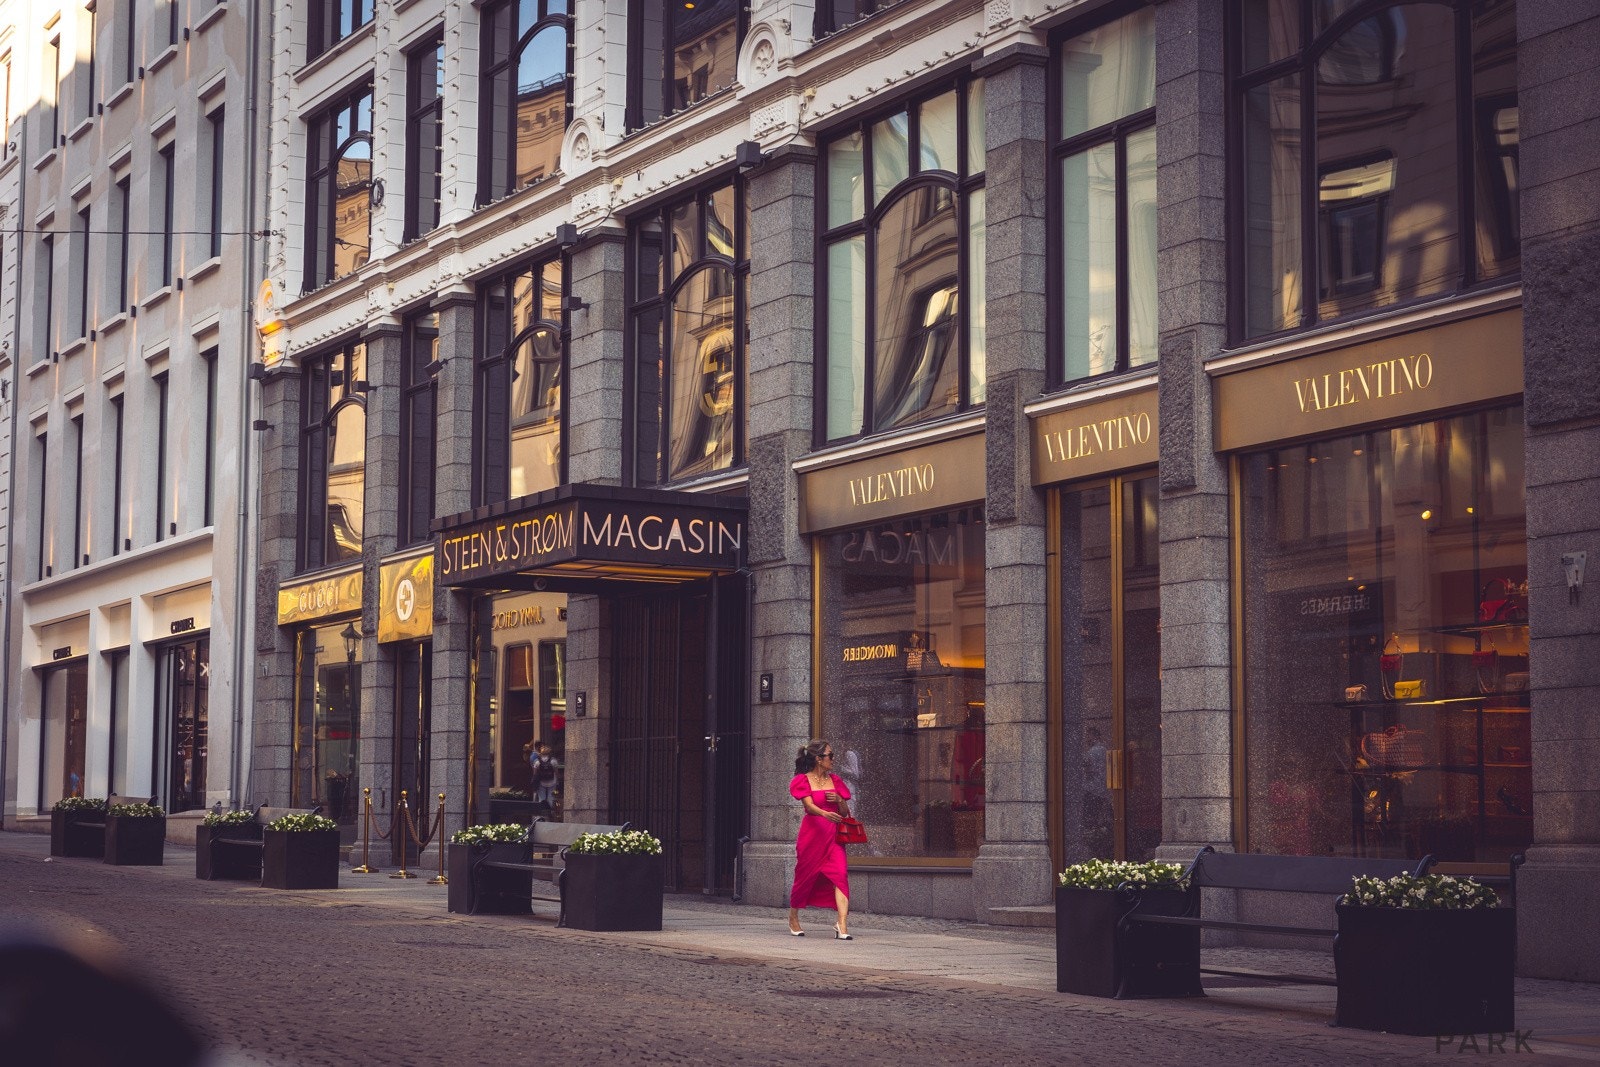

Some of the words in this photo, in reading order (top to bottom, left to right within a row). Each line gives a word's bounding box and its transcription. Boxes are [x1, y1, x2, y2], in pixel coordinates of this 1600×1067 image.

[1294, 353, 1433, 413] VALENTINO
[1044, 412, 1151, 463] VALENTINO
[849, 463, 935, 506] VALENTINO
[443, 530, 491, 574] STEEN
[495, 525, 508, 562] &
[511, 510, 573, 560] STRØM
[583, 511, 741, 555] MAGASIN
[299, 585, 339, 613] GUCCI
